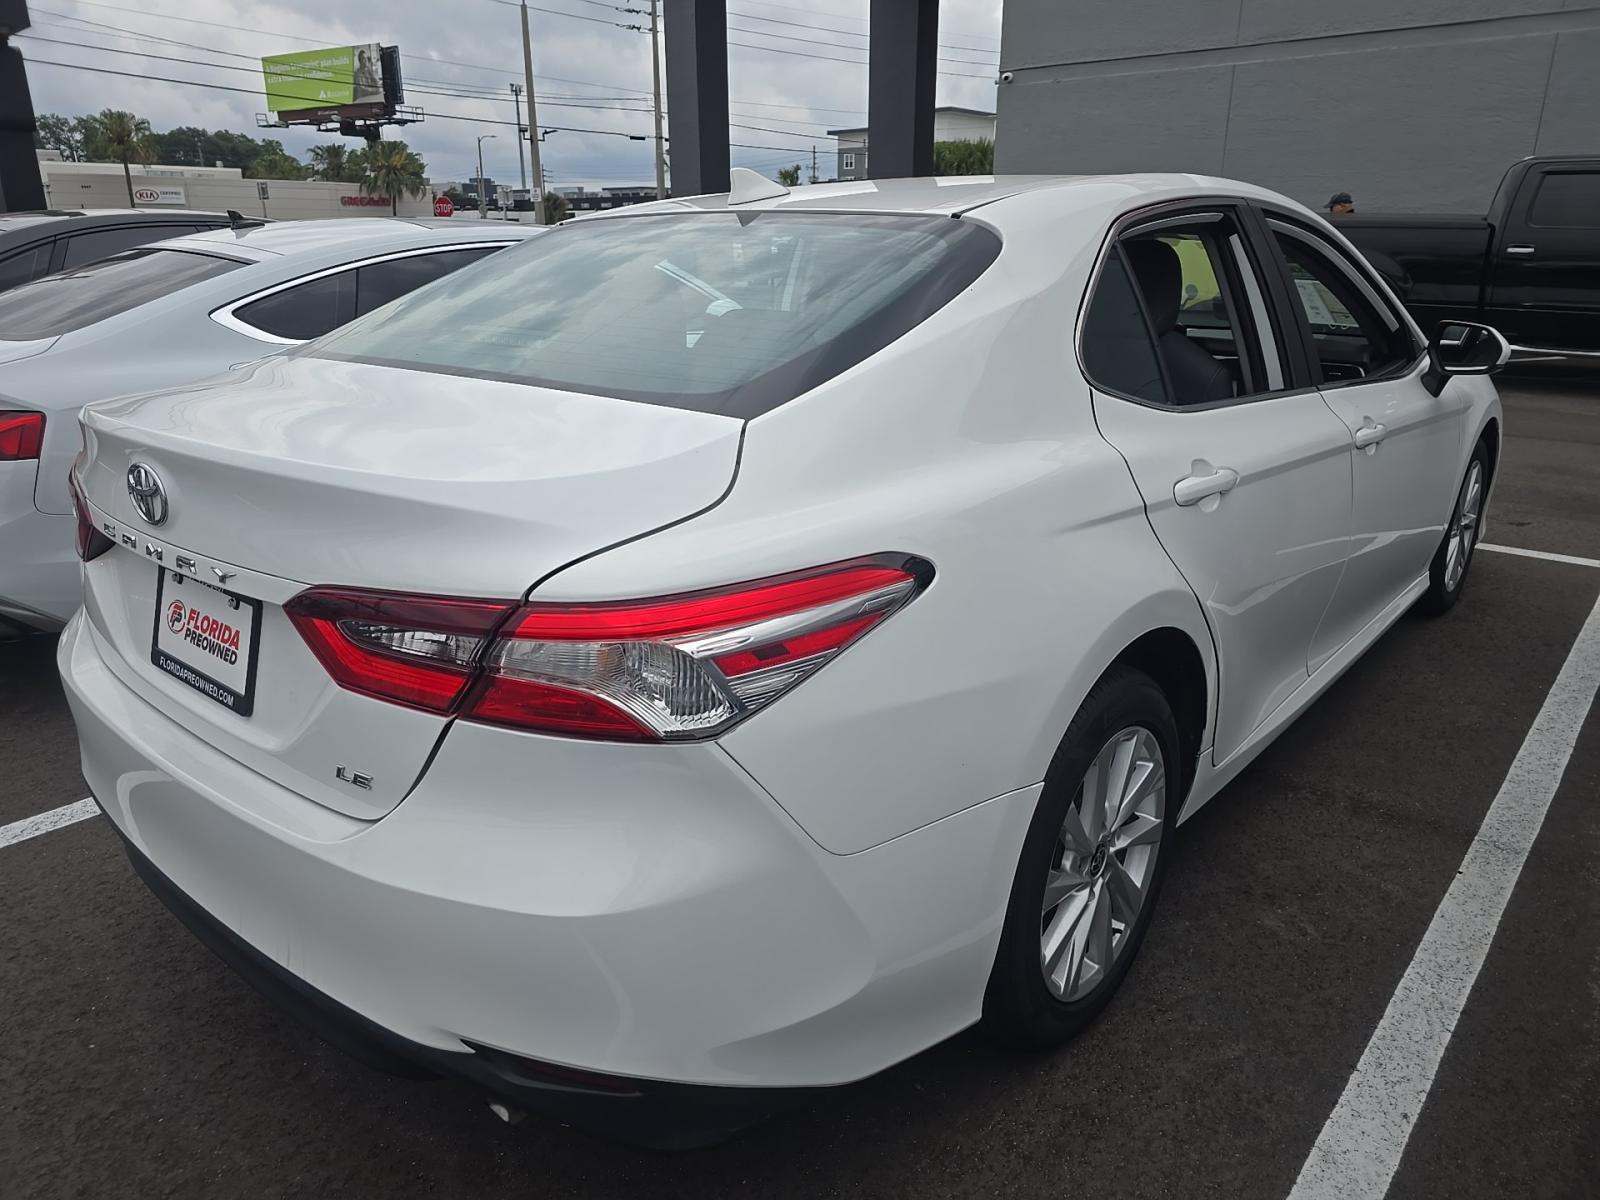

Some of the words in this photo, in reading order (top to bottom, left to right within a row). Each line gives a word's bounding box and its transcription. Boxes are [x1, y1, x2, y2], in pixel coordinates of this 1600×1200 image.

[435, 203, 452, 213] STOP
[104, 523, 237, 584] CAMRY
[184, 627, 238, 666] PREOWNED
[187, 608, 241, 650] FLORIDA
[159, 656, 234, 707] FLORIDAPREOWNED.COM
[336, 764, 373, 790] LE
